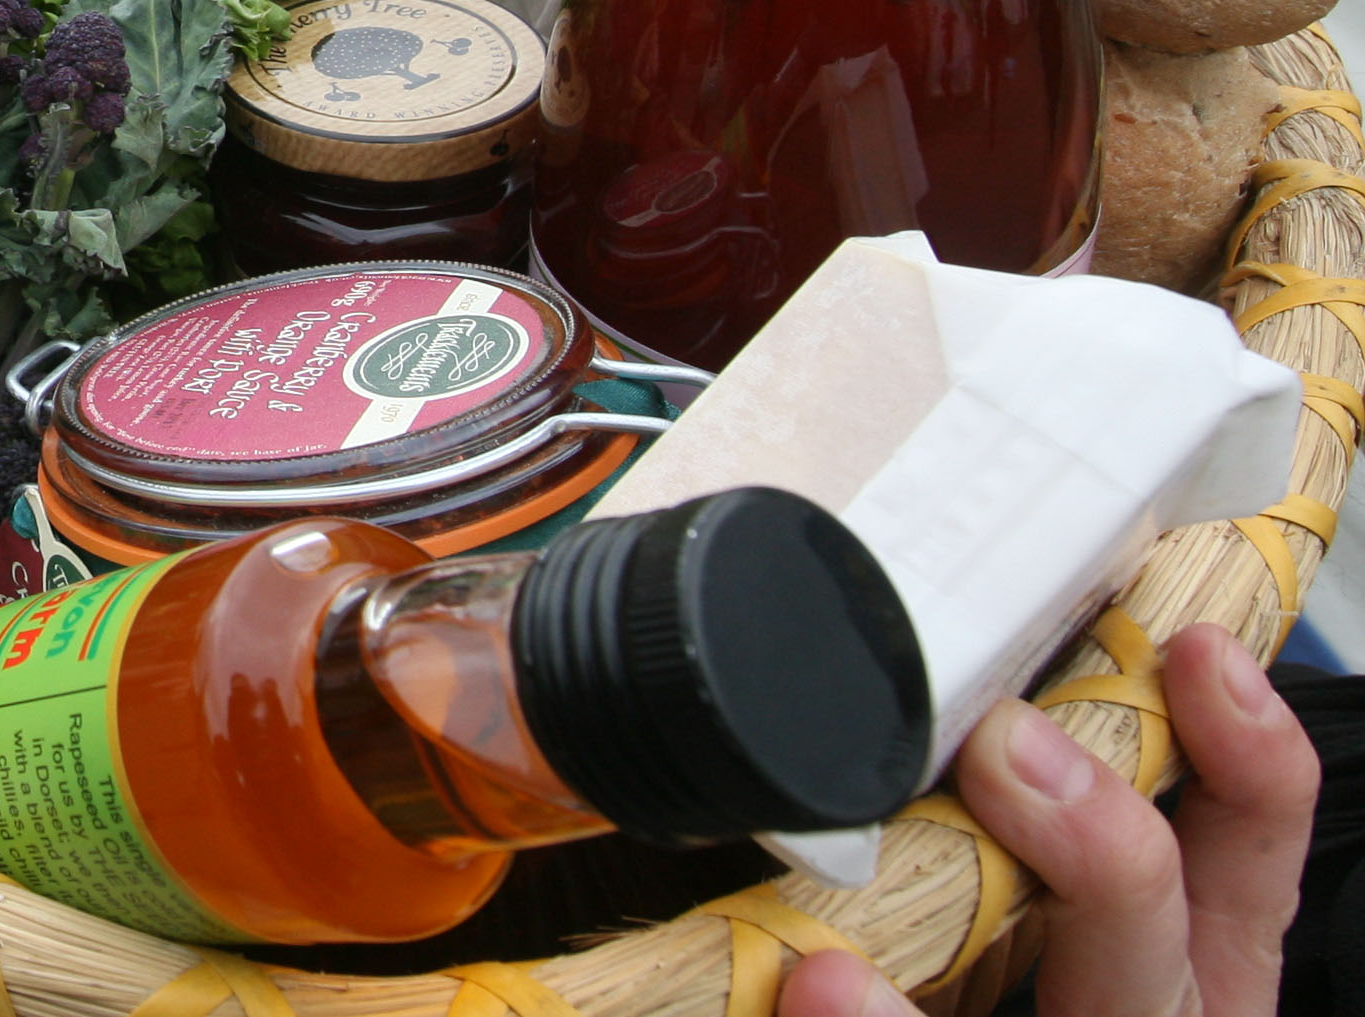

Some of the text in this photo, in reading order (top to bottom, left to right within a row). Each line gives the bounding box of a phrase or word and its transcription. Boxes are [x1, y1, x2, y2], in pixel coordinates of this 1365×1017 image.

[261, 45, 292, 77] The
[289, 1, 351, 36] herry
[302, 98, 377, 120] AWARD
[394, 89, 485, 121] WINNING
[240, 298, 258, 309] The
[331, 280, 376, 307] 690g
[182, 329, 263, 395] with Port
[186, 356, 203, 367] for
[209, 311, 331, 419] Orange Sauce
[267, 312, 376, 412] Cranberry &
[398, 318, 477, 392] Tracklements
[381, 403, 403, 423] 1970
[2, 586, 79, 671] arm
[14, 729, 28, 774] with
[20, 782, 32, 795] a
[32, 737, 44, 758] in
[68, 849, 92, 878] we
[51, 742, 65, 774] for
[58, 780, 74, 807] us
[69, 813, 90, 840] by
[87, 845, 126, 887] THE
[68, 712, 109, 830] Rapeseed
[102, 837, 130, 865] Oil
[26, 802, 64, 861] blend
[99, 774, 168, 889] This single
[25, 844, 61, 885] filter
[59, 866, 80, 884] of
